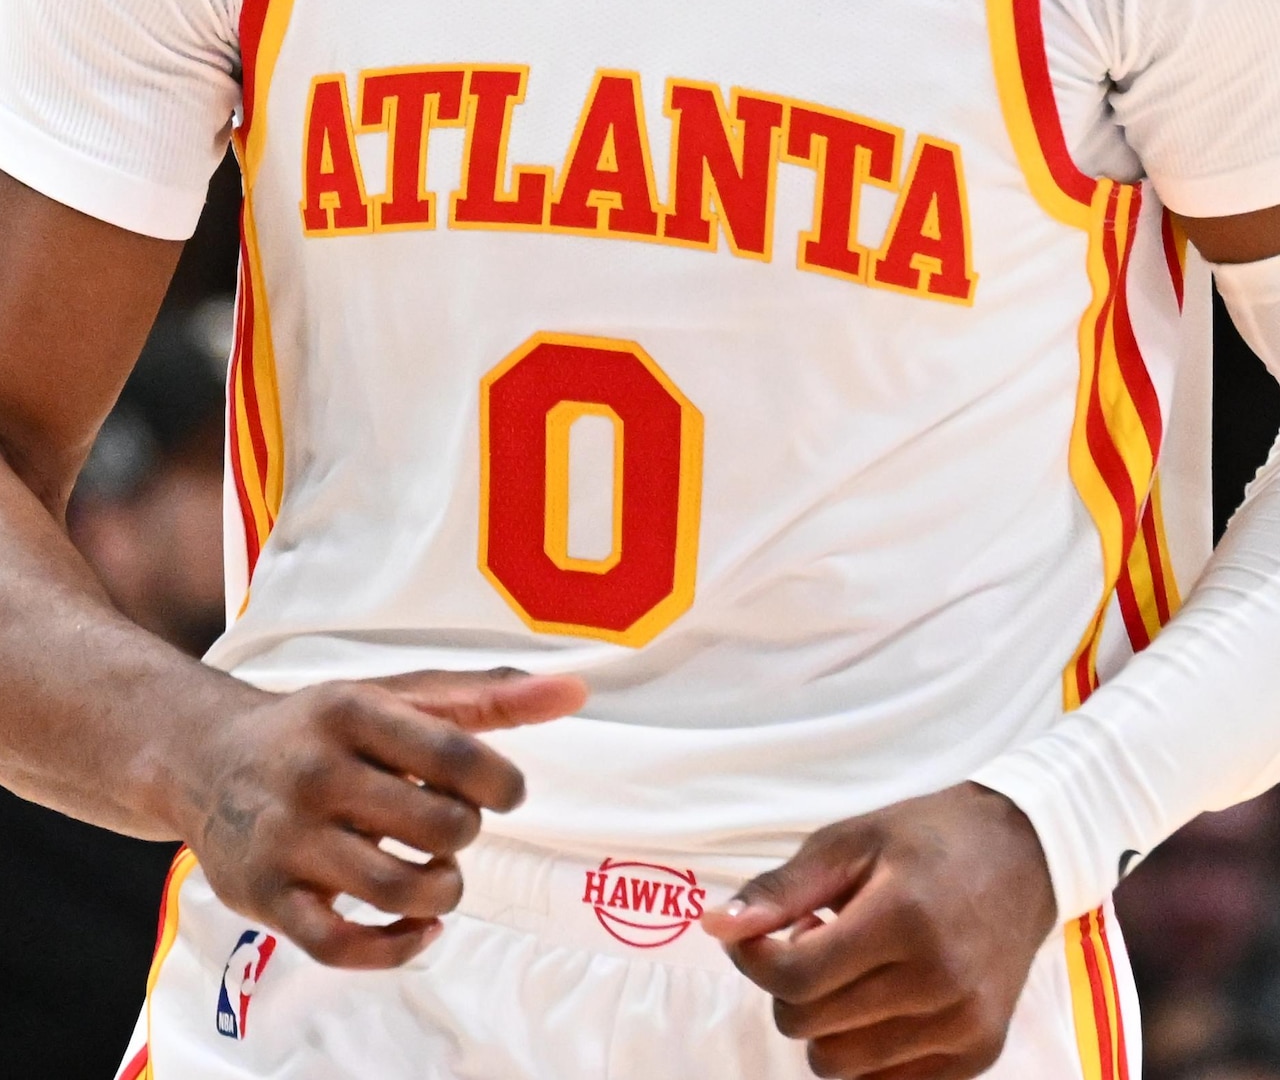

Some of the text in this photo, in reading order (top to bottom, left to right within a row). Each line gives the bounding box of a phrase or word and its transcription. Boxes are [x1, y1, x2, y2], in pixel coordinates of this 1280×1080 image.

[301, 62, 979, 307] ATLANTA
[477, 330, 704, 649] 0
[582, 871, 706, 920] HAWKS
[218, 1011, 235, 1034] NBA
